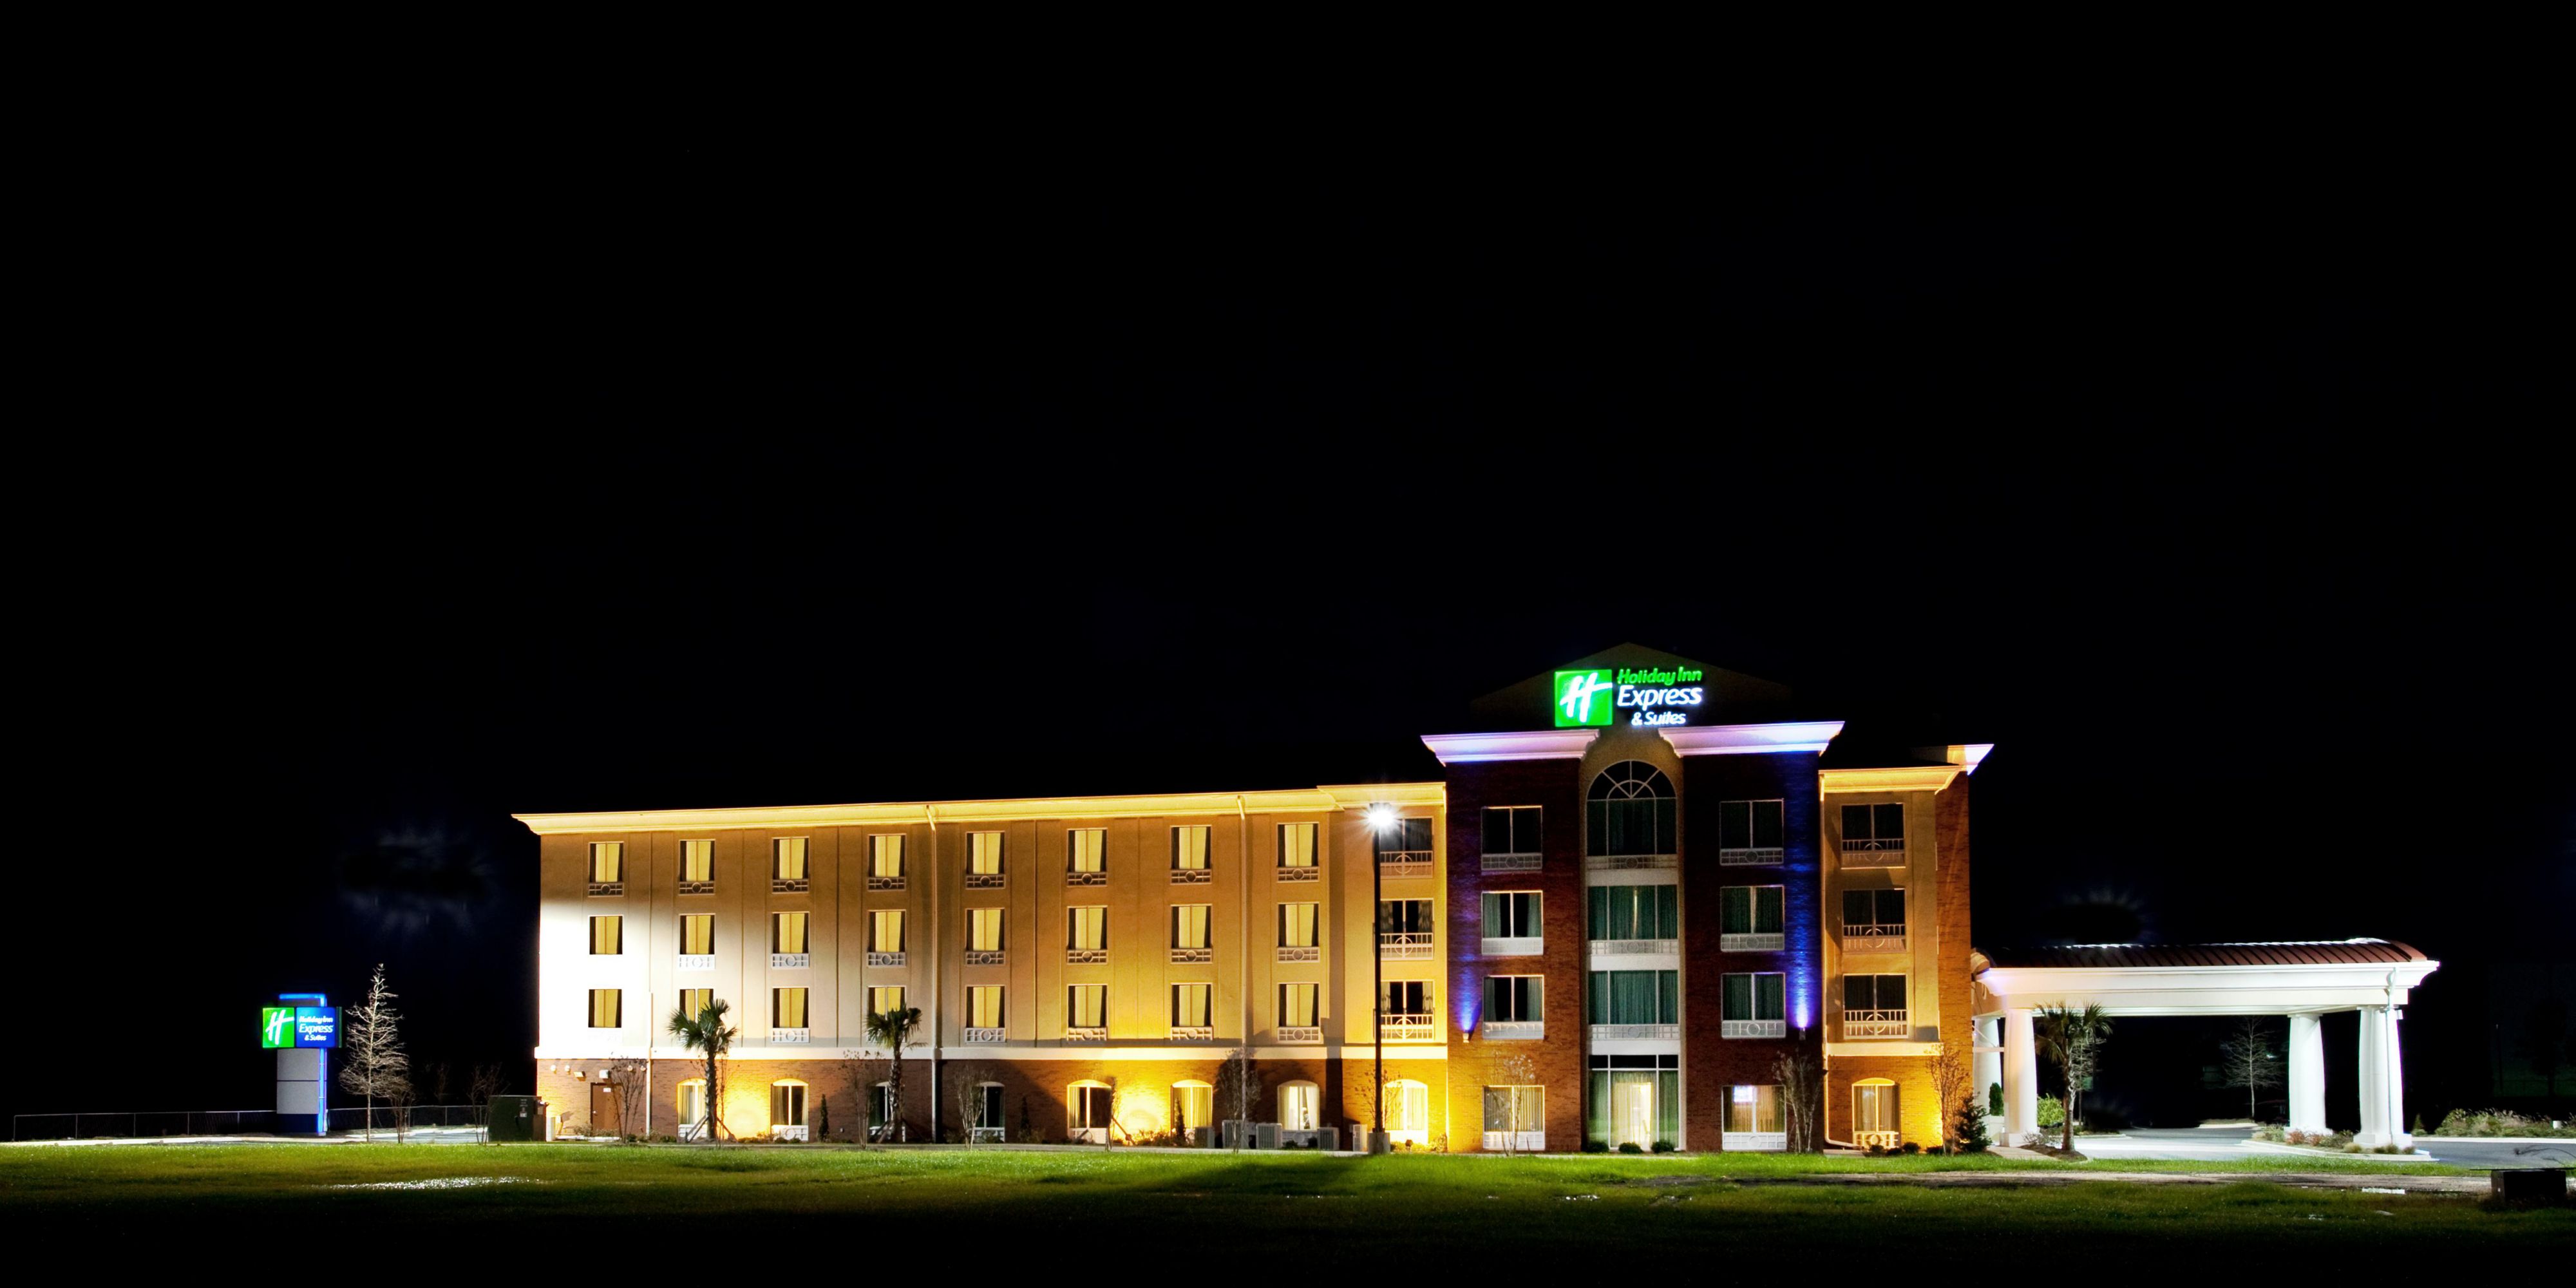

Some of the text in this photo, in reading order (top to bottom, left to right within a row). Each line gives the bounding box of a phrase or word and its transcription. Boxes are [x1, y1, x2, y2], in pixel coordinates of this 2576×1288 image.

[1617, 666, 1702, 686] Holiday Inn
[1617, 685, 1703, 711] Express
[1631, 711, 1687, 726] & Suites
[299, 1023, 334, 1035] Express
